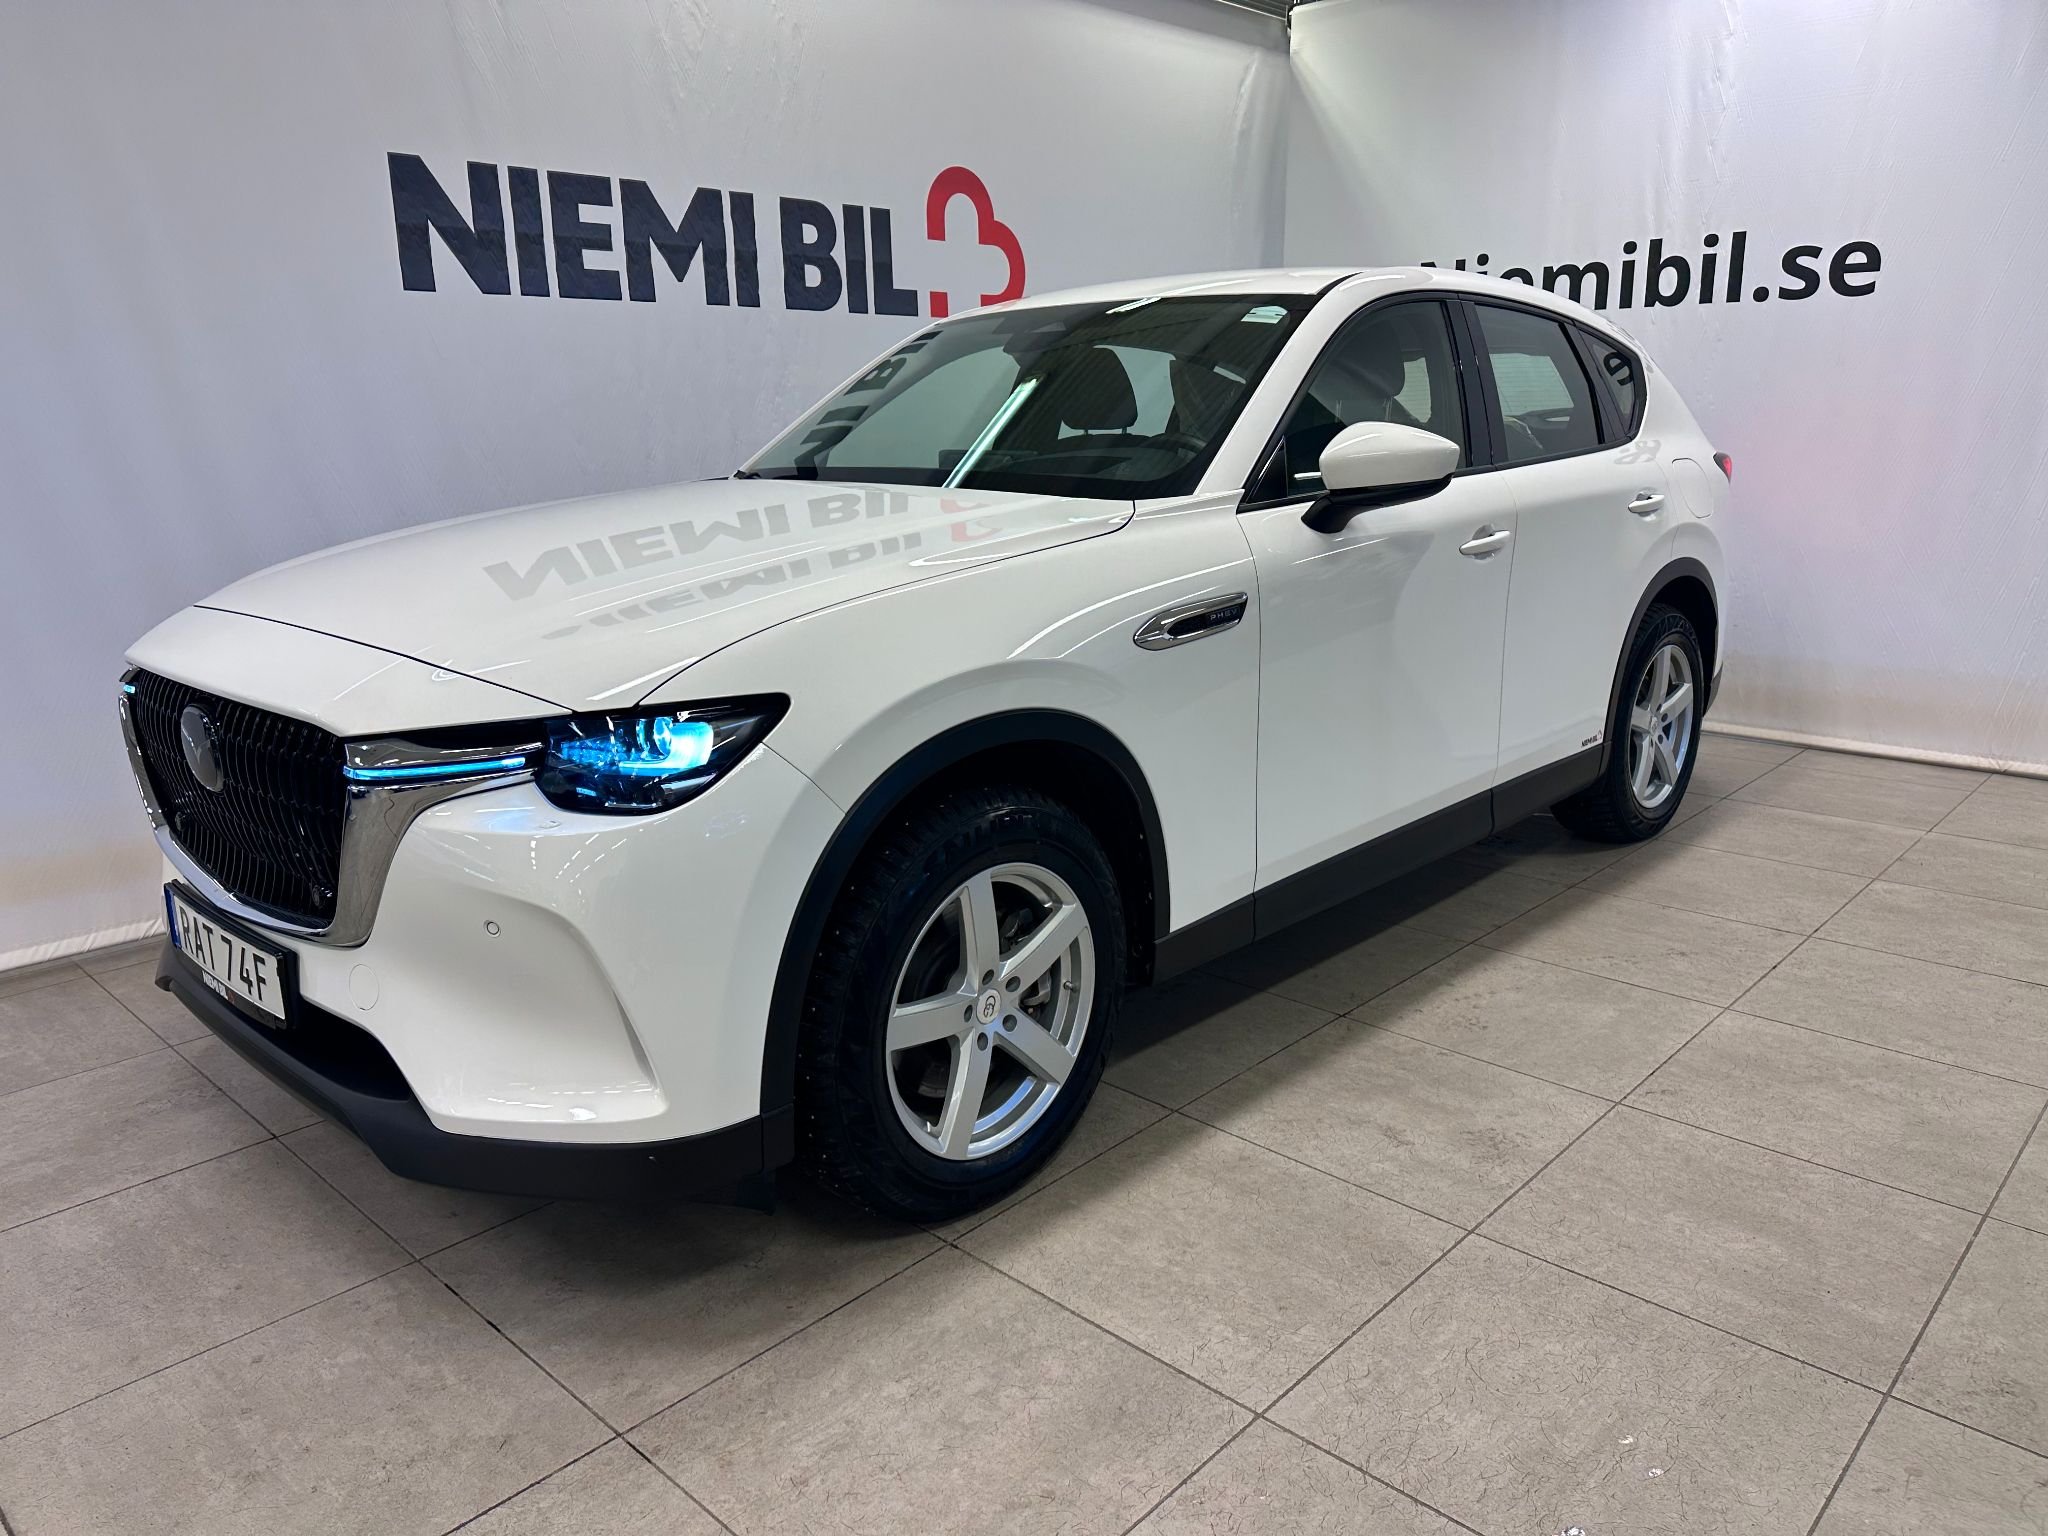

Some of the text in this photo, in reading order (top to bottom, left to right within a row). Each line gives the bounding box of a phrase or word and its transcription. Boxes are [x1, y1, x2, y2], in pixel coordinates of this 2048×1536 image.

[387, 151, 919, 317] NIEMI BIL
[1211, 609, 1237, 620] PHEV
[179, 905, 267, 1001] RAT 74F
